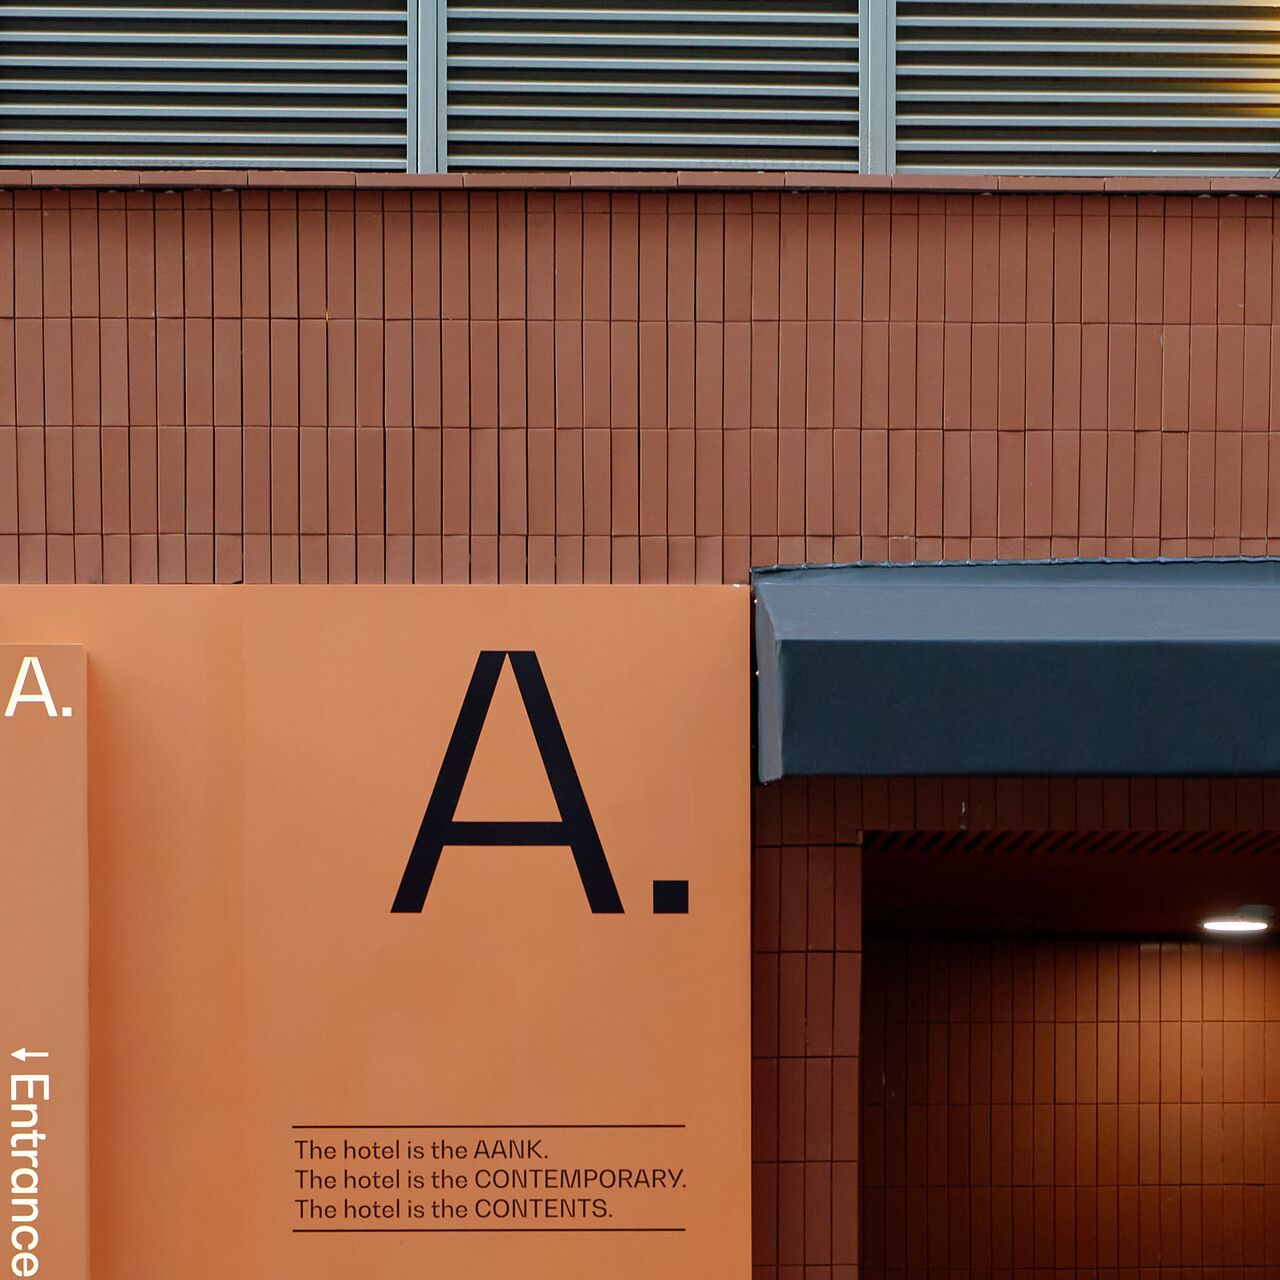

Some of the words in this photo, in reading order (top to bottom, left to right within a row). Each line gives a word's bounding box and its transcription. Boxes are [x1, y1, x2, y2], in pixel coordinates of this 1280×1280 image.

[5, 657, 72, 716] A.
[390, 651, 689, 914] A.
[295, 1140, 336, 1159] The
[344, 1140, 399, 1159] hotel
[408, 1141, 424, 1159] is
[431, 1140, 467, 1159] the
[474, 1140, 548, 1158] AANK.
[295, 1169, 336, 1189] The
[345, 1169, 399, 1189] hotel
[408, 1170, 424, 1188] is
[431, 1169, 467, 1188] the
[475, 1169, 686, 1188] CONTEMPORARY.
[295, 1199, 336, 1218] The
[345, 1199, 399, 1218] hotel
[408, 1200, 424, 1218] is
[432, 1199, 467, 1218] the
[475, 1199, 612, 1218] CONTENTS.
